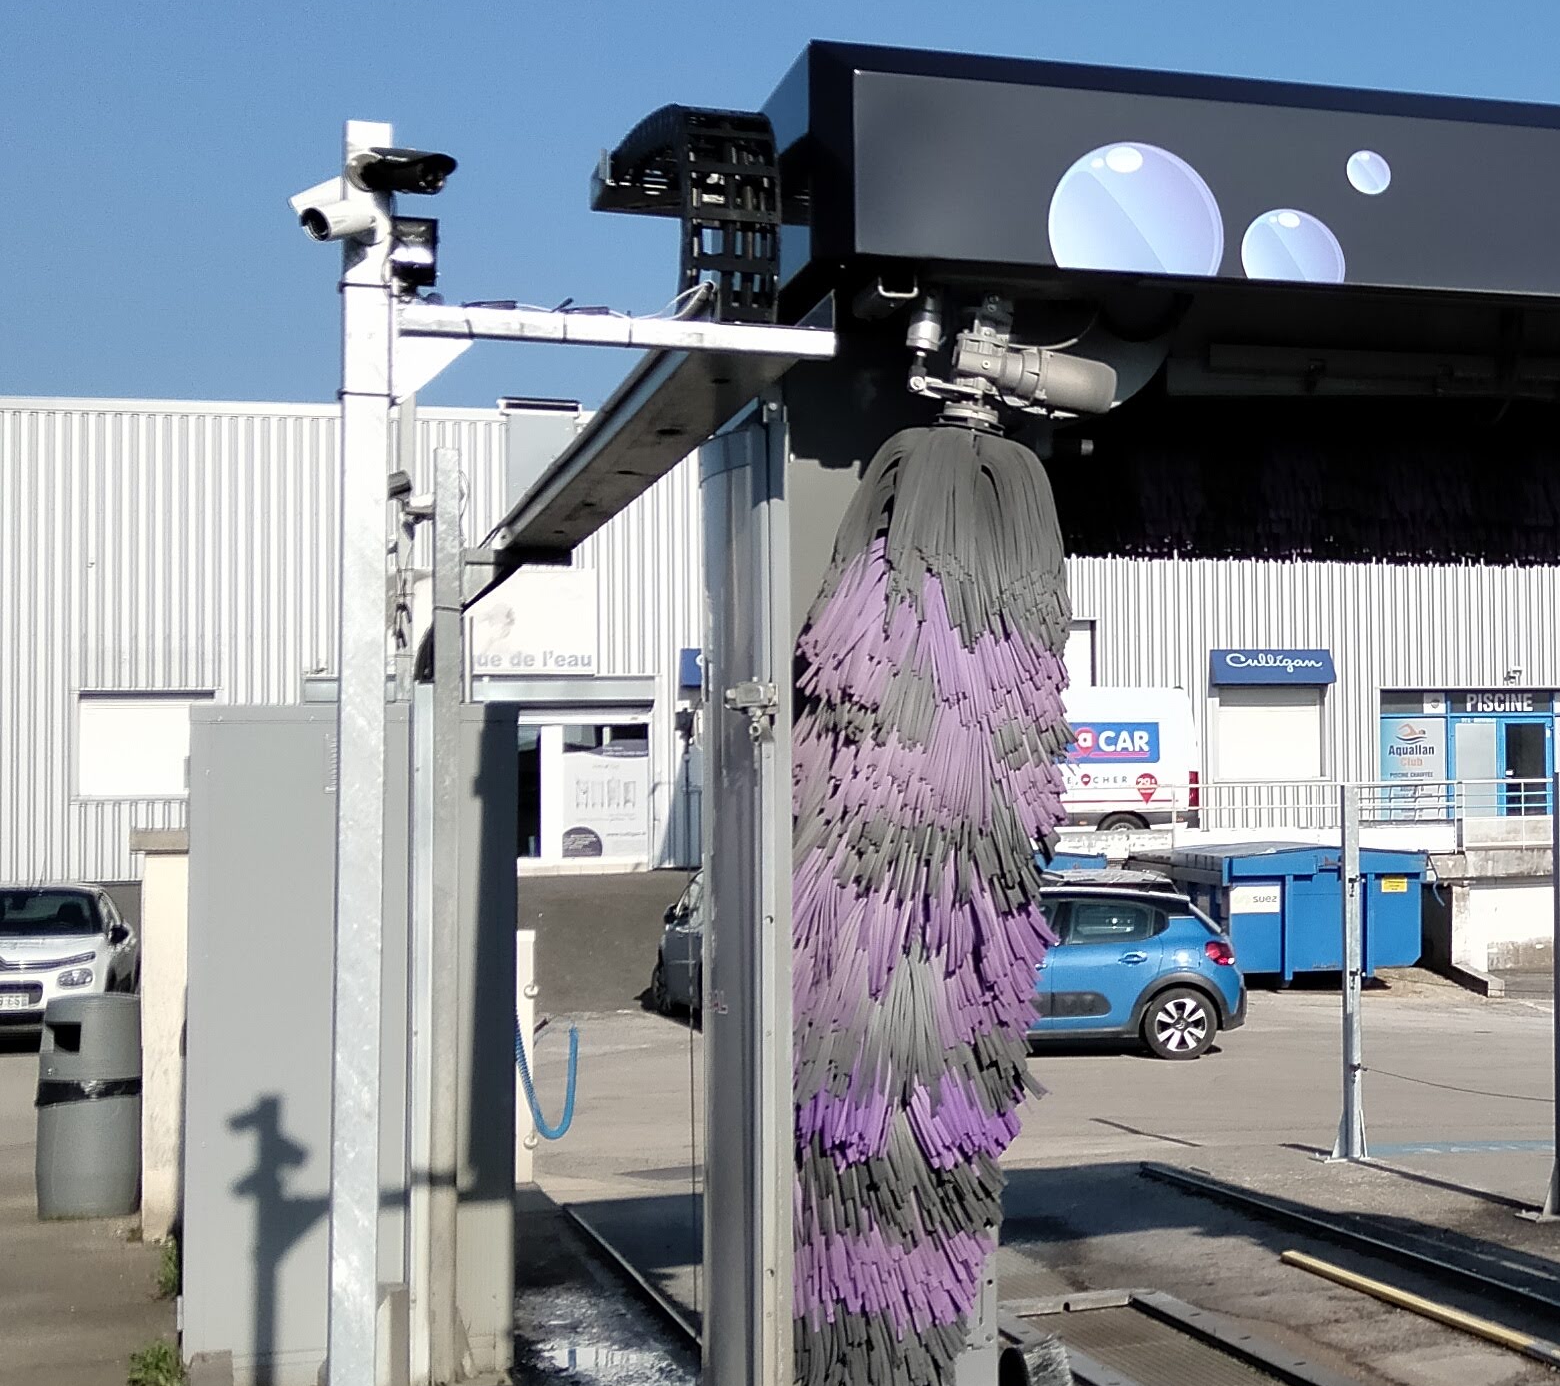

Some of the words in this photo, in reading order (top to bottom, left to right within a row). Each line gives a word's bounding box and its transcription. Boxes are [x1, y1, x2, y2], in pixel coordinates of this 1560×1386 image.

[510, 651, 535, 668] de
[543, 651, 592, 668] l'eau
[1225, 653, 1323, 673] Culligan
[1466, 693, 1534, 712] PISCINE
[1098, 730, 1150, 752] CAR
[1400, 757, 1423, 767] Club
[1093, 775, 1128, 784] CHER
[1252, 895, 1278, 903] suez
